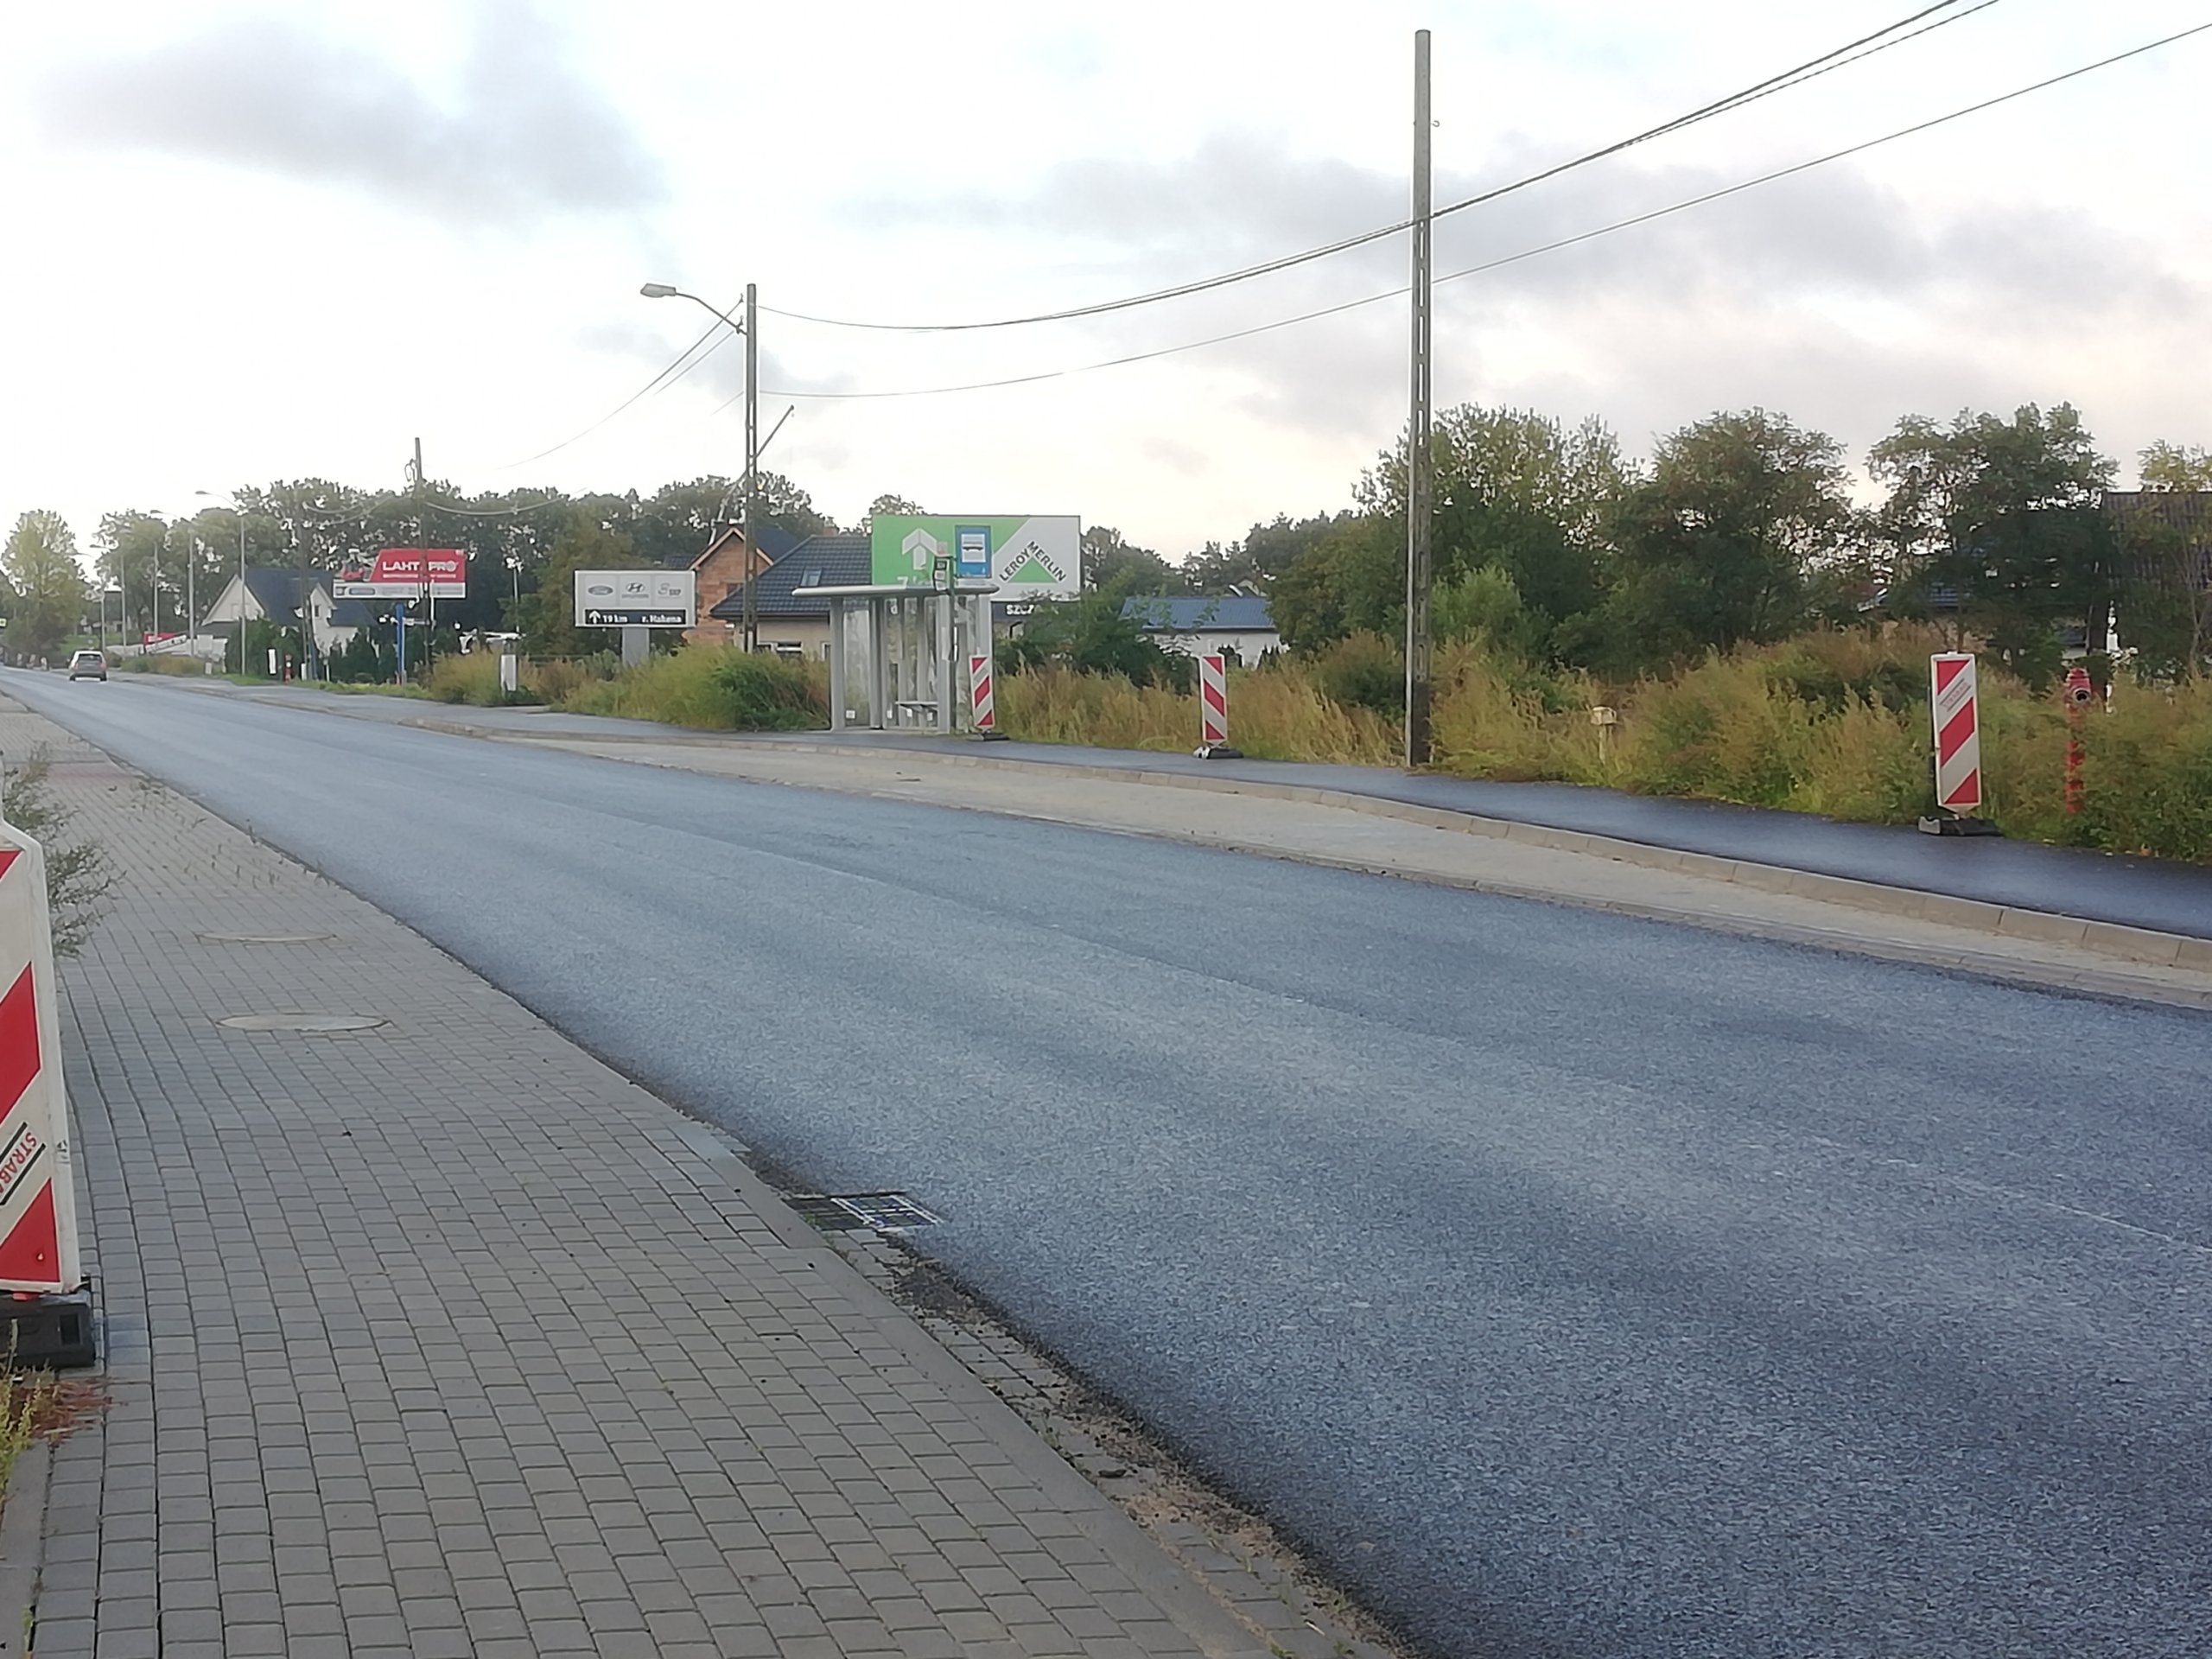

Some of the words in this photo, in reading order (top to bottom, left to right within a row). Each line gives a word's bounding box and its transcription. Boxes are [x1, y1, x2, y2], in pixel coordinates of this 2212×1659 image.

[382, 561, 423, 571] LAHT
[999, 548, 1030, 582] LEROY
[1027, 541, 1066, 582] MERLIN
[613, 614, 628, 623] km
